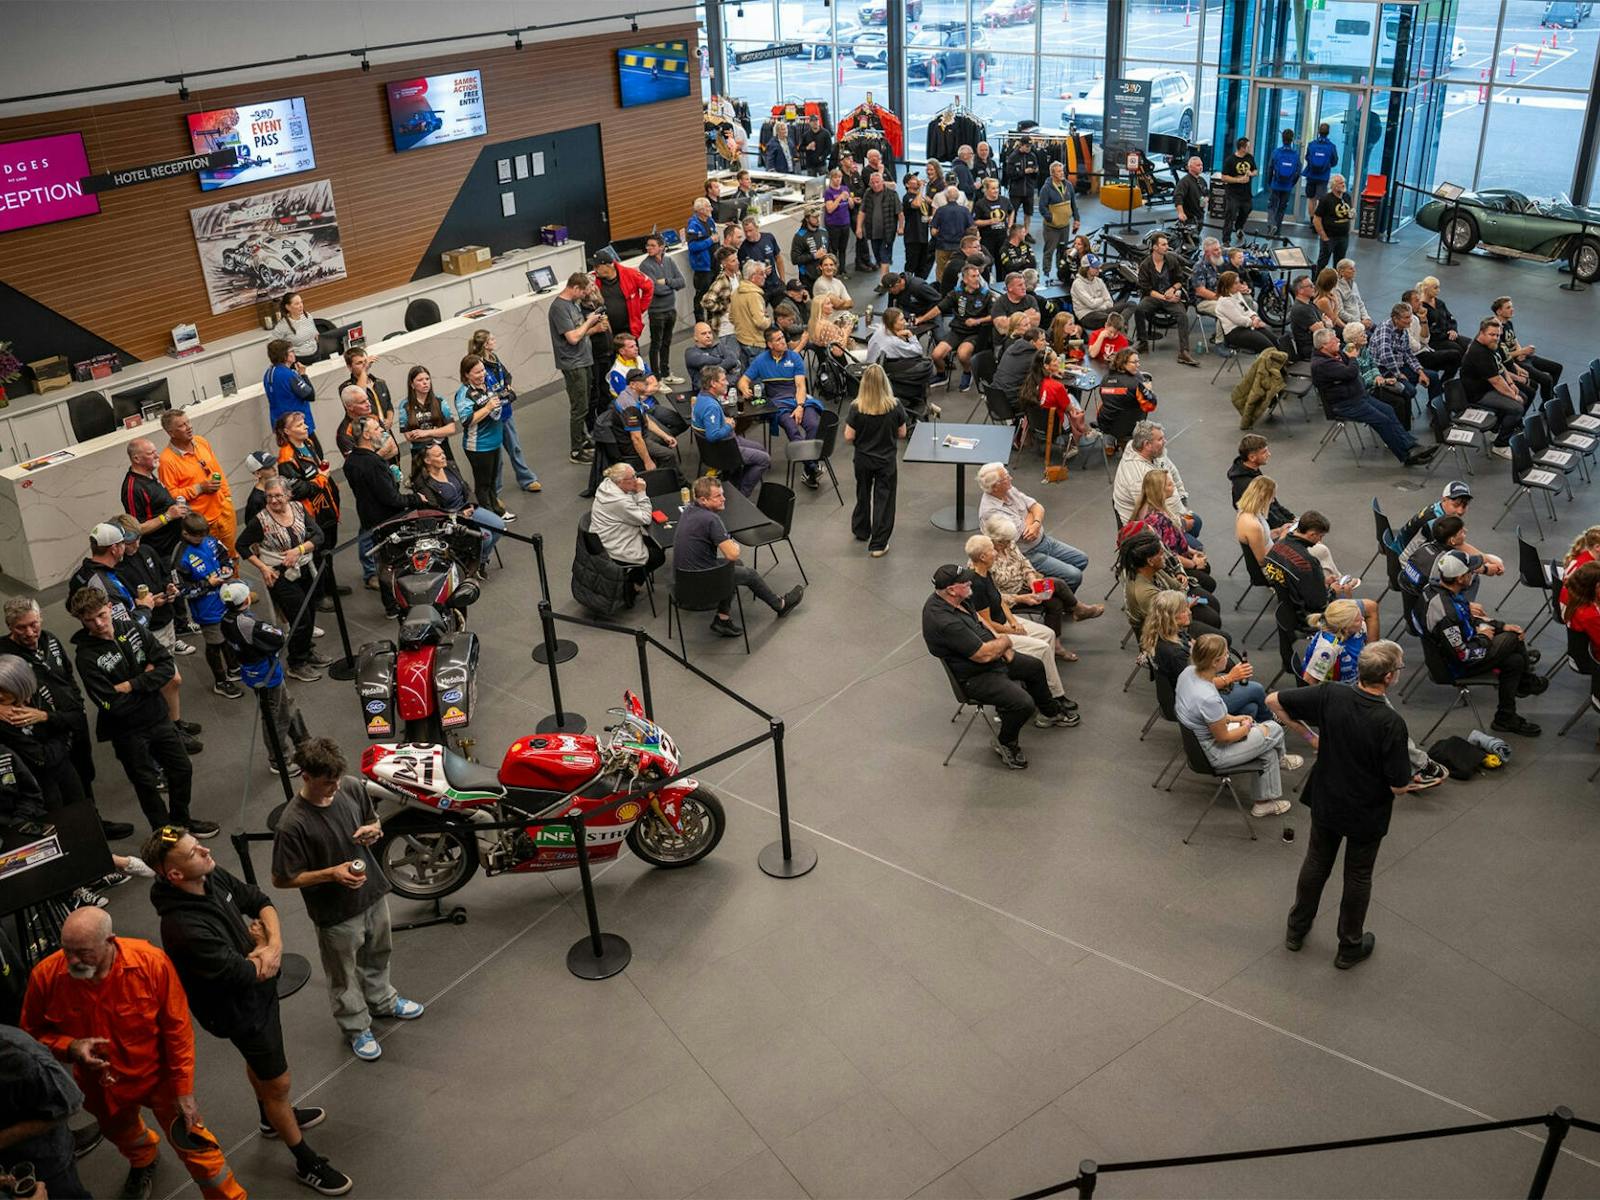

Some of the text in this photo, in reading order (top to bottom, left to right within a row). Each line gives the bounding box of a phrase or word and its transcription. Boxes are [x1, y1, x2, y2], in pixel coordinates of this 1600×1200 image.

[453, 84, 479, 94] ACTION
[463, 90, 479, 99] FREE
[459, 97, 480, 107] ENTRY
[251, 118, 282, 135] EVENT
[254, 133, 279, 148] PASS
[113, 156, 210, 186] HOTEL RECEPTION
[392, 755, 434, 786] 21
